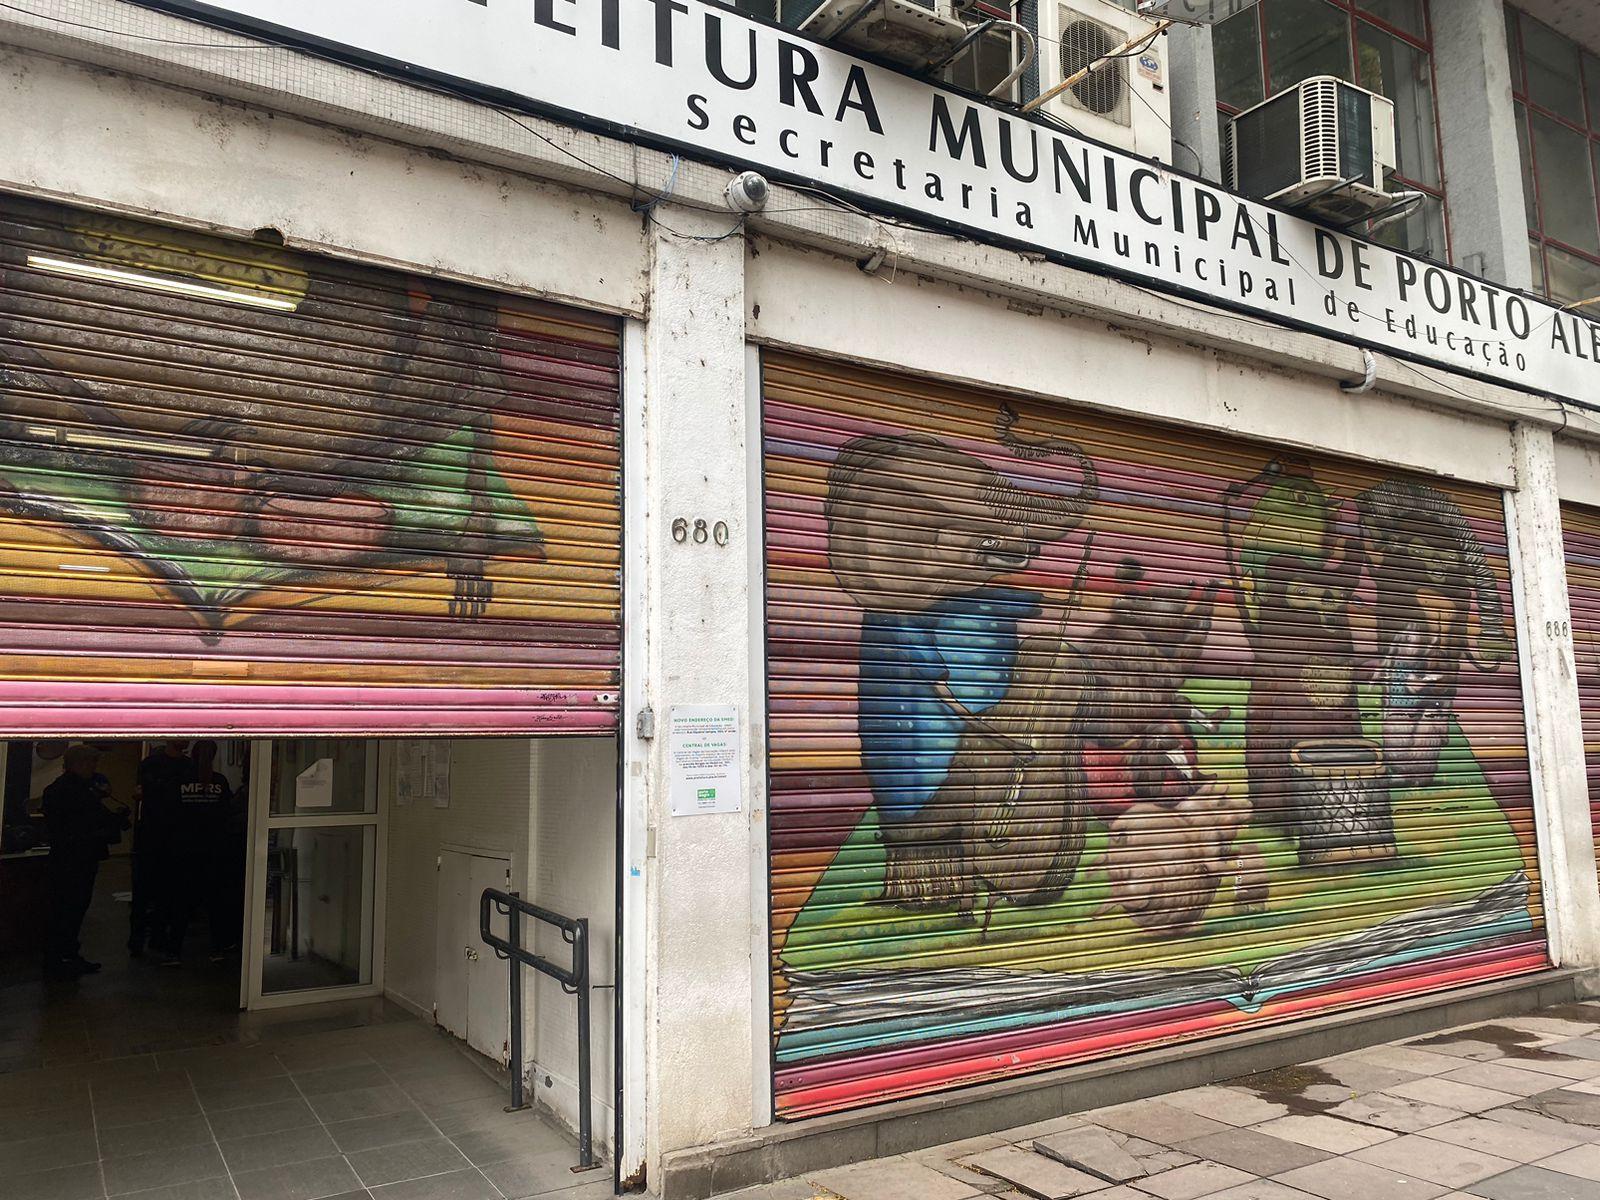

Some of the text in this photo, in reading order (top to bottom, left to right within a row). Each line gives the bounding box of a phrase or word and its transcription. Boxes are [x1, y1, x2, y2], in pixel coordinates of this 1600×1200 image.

[686, 94, 1527, 372] Secretaria Municipal de Educação
[929, 94, 1290, 266] MUNICIPAL
[1314, 227, 1373, 291] DE
[1395, 255, 1531, 340] PORTO
[671, 517, 729, 548] 680
